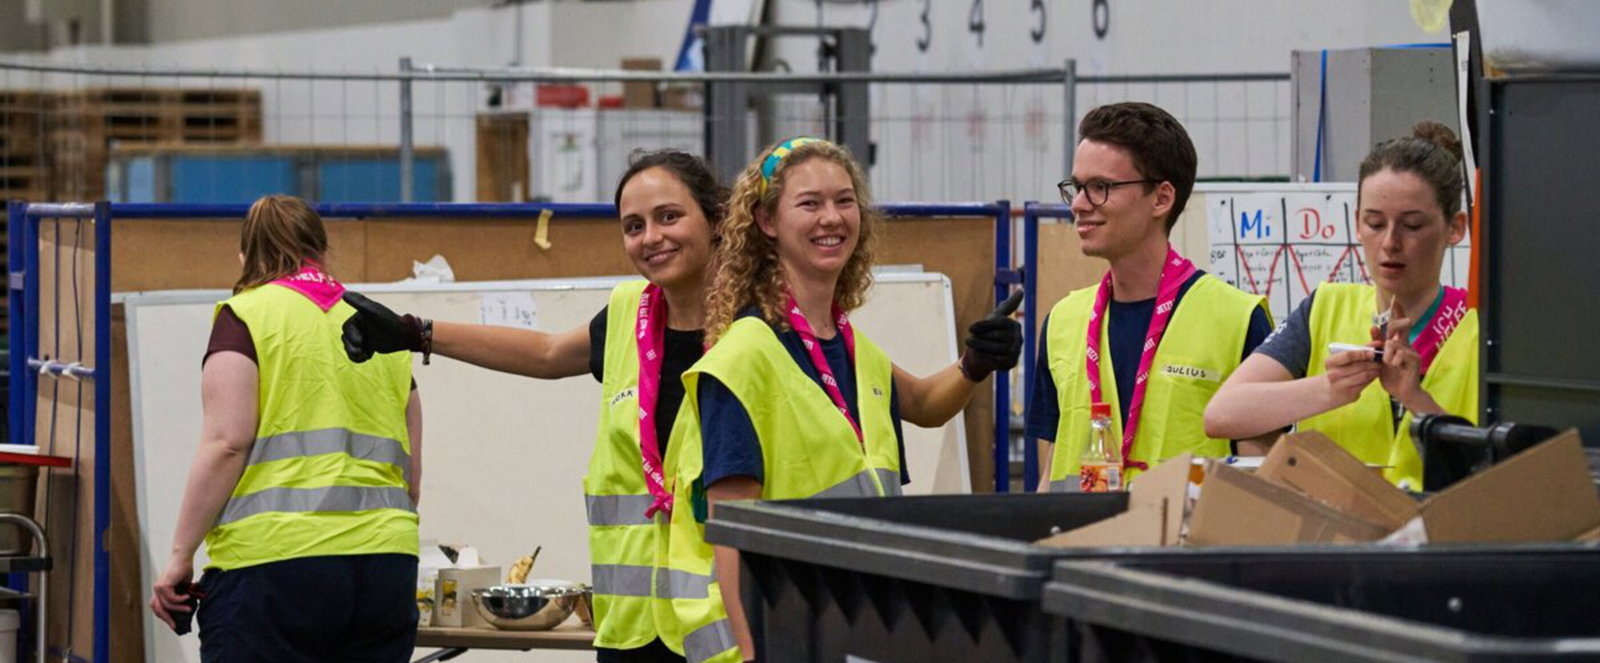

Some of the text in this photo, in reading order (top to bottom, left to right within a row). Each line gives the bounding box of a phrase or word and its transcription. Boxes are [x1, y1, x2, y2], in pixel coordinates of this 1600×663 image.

[916, 0, 932, 51] 3
[968, 0, 985, 47] 4
[1240, 209, 1271, 240] Mi
[1295, 207, 1335, 240] Do
[1432, 305, 1453, 334] ICH
[1166, 365, 1206, 378] JULIUS
